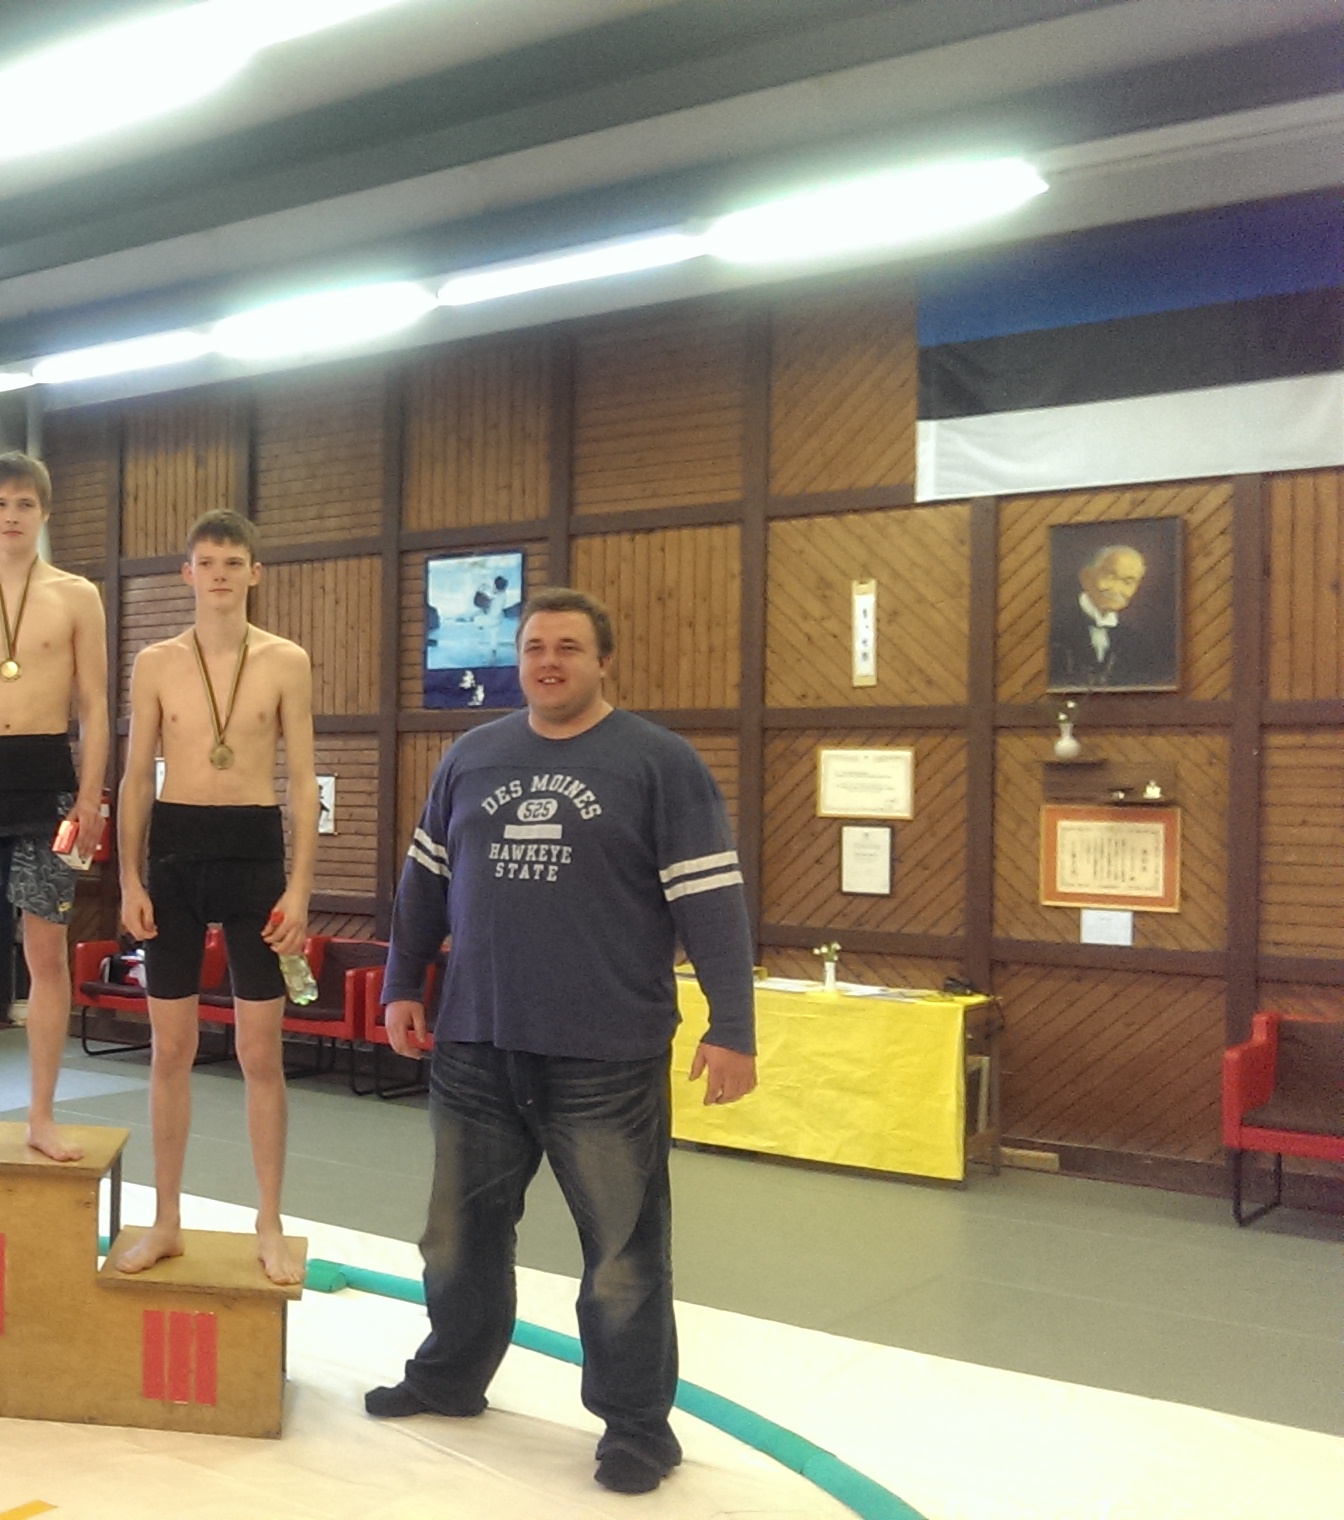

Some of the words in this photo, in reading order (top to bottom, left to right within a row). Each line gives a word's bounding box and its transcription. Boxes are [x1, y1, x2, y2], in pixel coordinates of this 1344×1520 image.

[481, 780, 523, 815] DES
[530, 774, 602, 820] MOINES
[522, 801, 552, 819] 525
[489, 843, 573, 864] HAWKEYE
[495, 862, 559, 882] STATE
